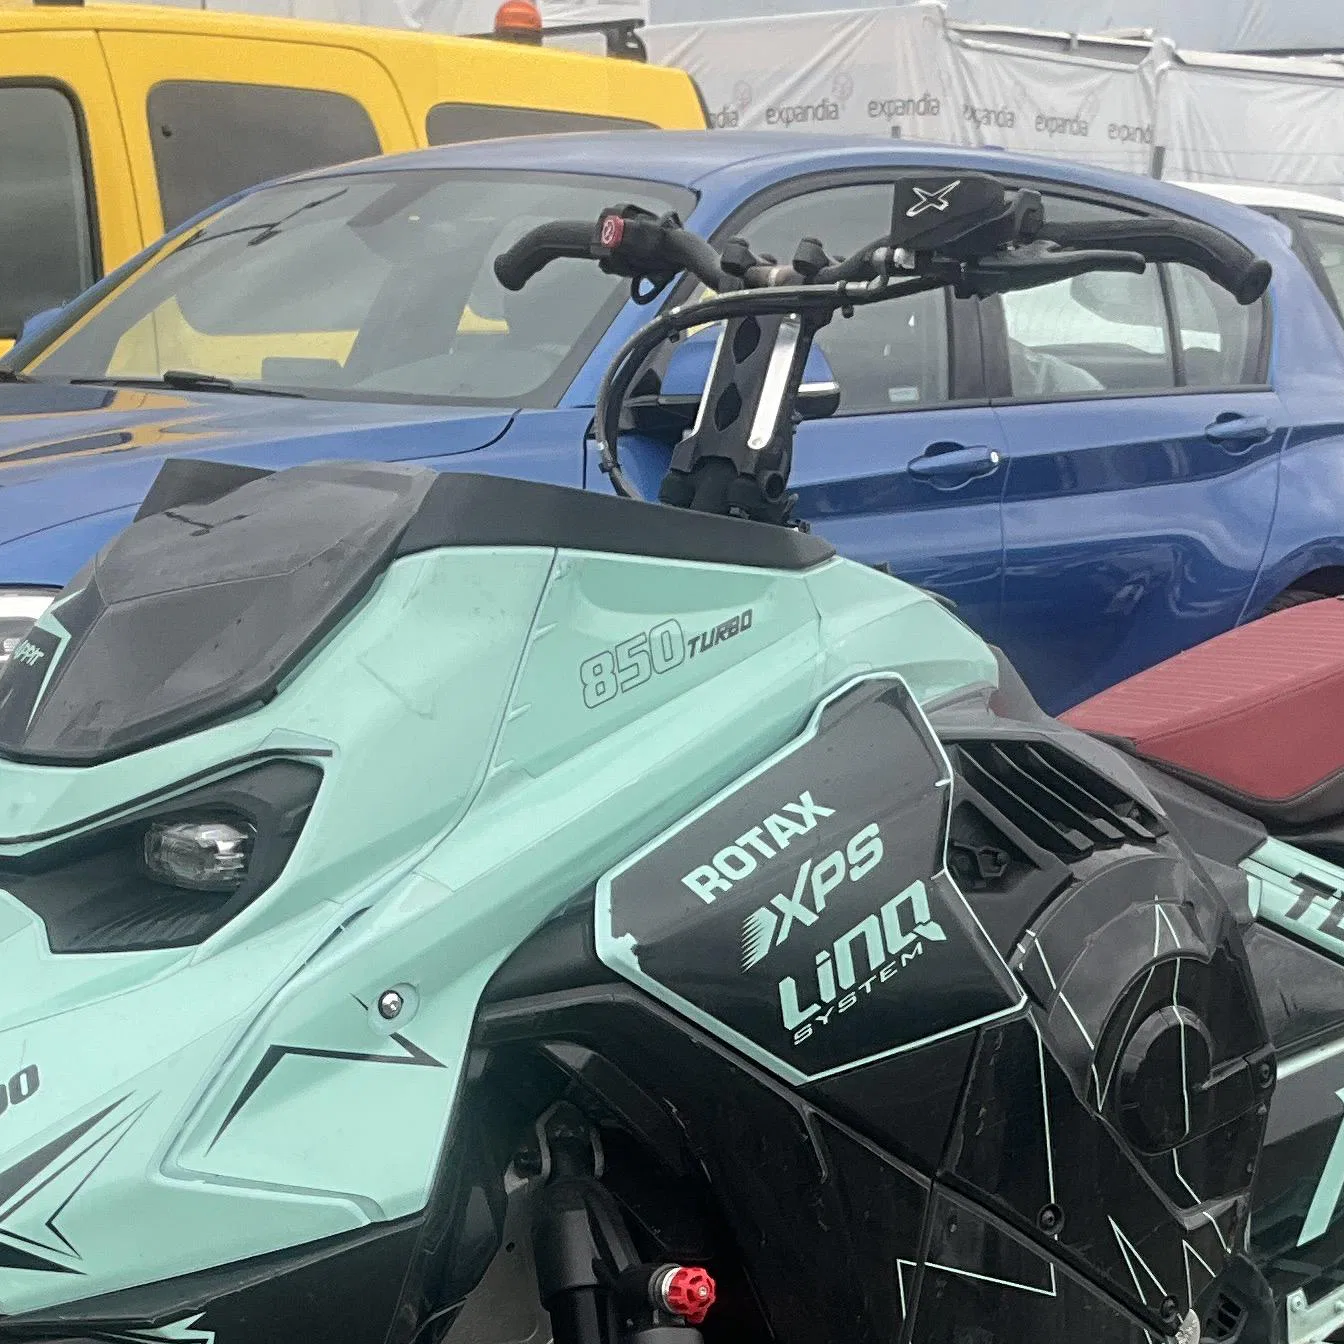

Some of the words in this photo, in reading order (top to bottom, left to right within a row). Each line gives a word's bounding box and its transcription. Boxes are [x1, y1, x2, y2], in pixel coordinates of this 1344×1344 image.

[580, 618, 686, 709] 850
[687, 609, 753, 659] TURBO
[680, 790, 836, 904] ROTAX
[769, 822, 884, 947] XPS
[793, 941, 924, 1046] SYSTEM
